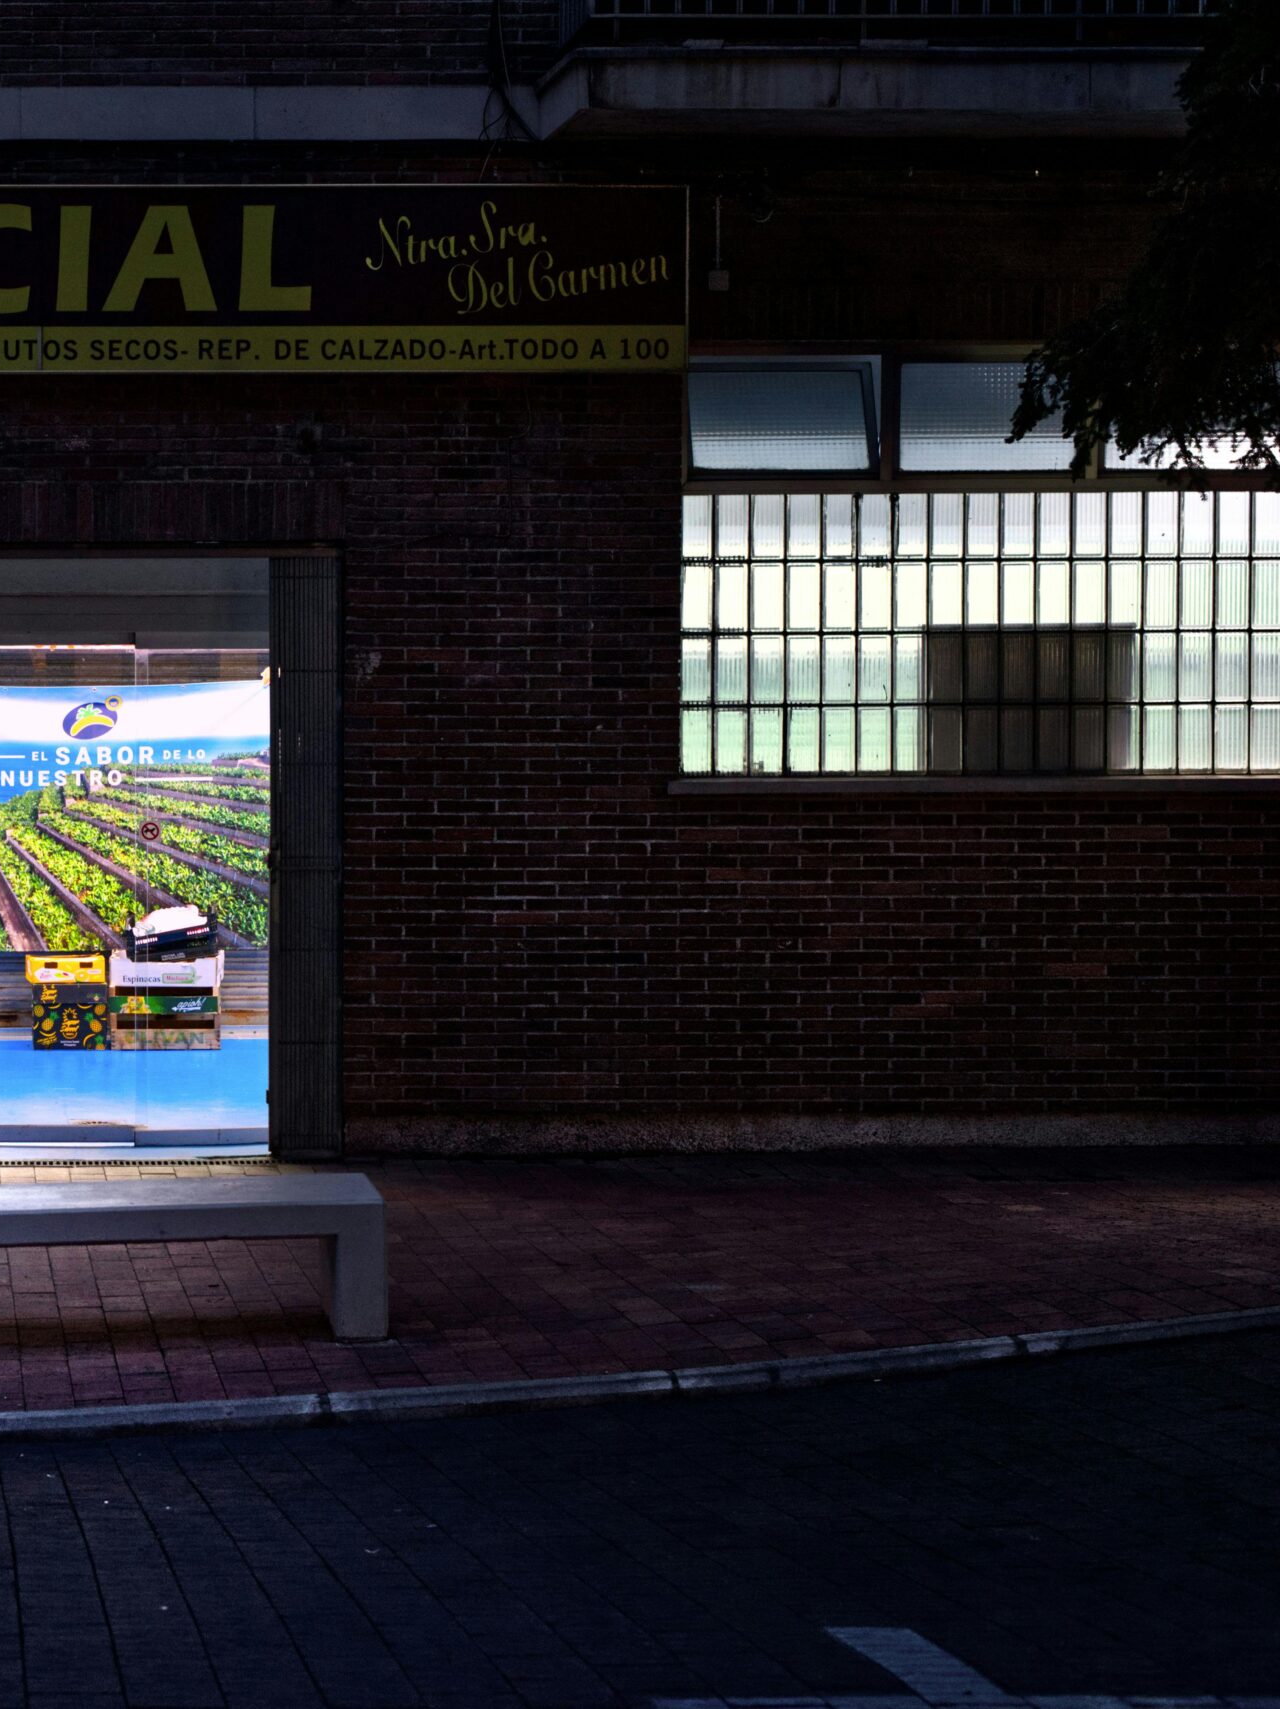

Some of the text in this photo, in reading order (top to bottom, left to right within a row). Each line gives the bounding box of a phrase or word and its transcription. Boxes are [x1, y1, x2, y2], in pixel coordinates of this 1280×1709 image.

[365, 200, 549, 271] Ntra. Sra.
[447, 250, 671, 315] Del Carmen
[197, 339, 260, 361] REP.
[274, 339, 309, 361] DE
[590, 338, 606, 361] A
[620, 338, 669, 360] 100
[31, 746, 206, 765] EL SABOR DE LO
[0, 769, 123, 787] NUESTRO
[122, 975, 161, 985] Espinacas
